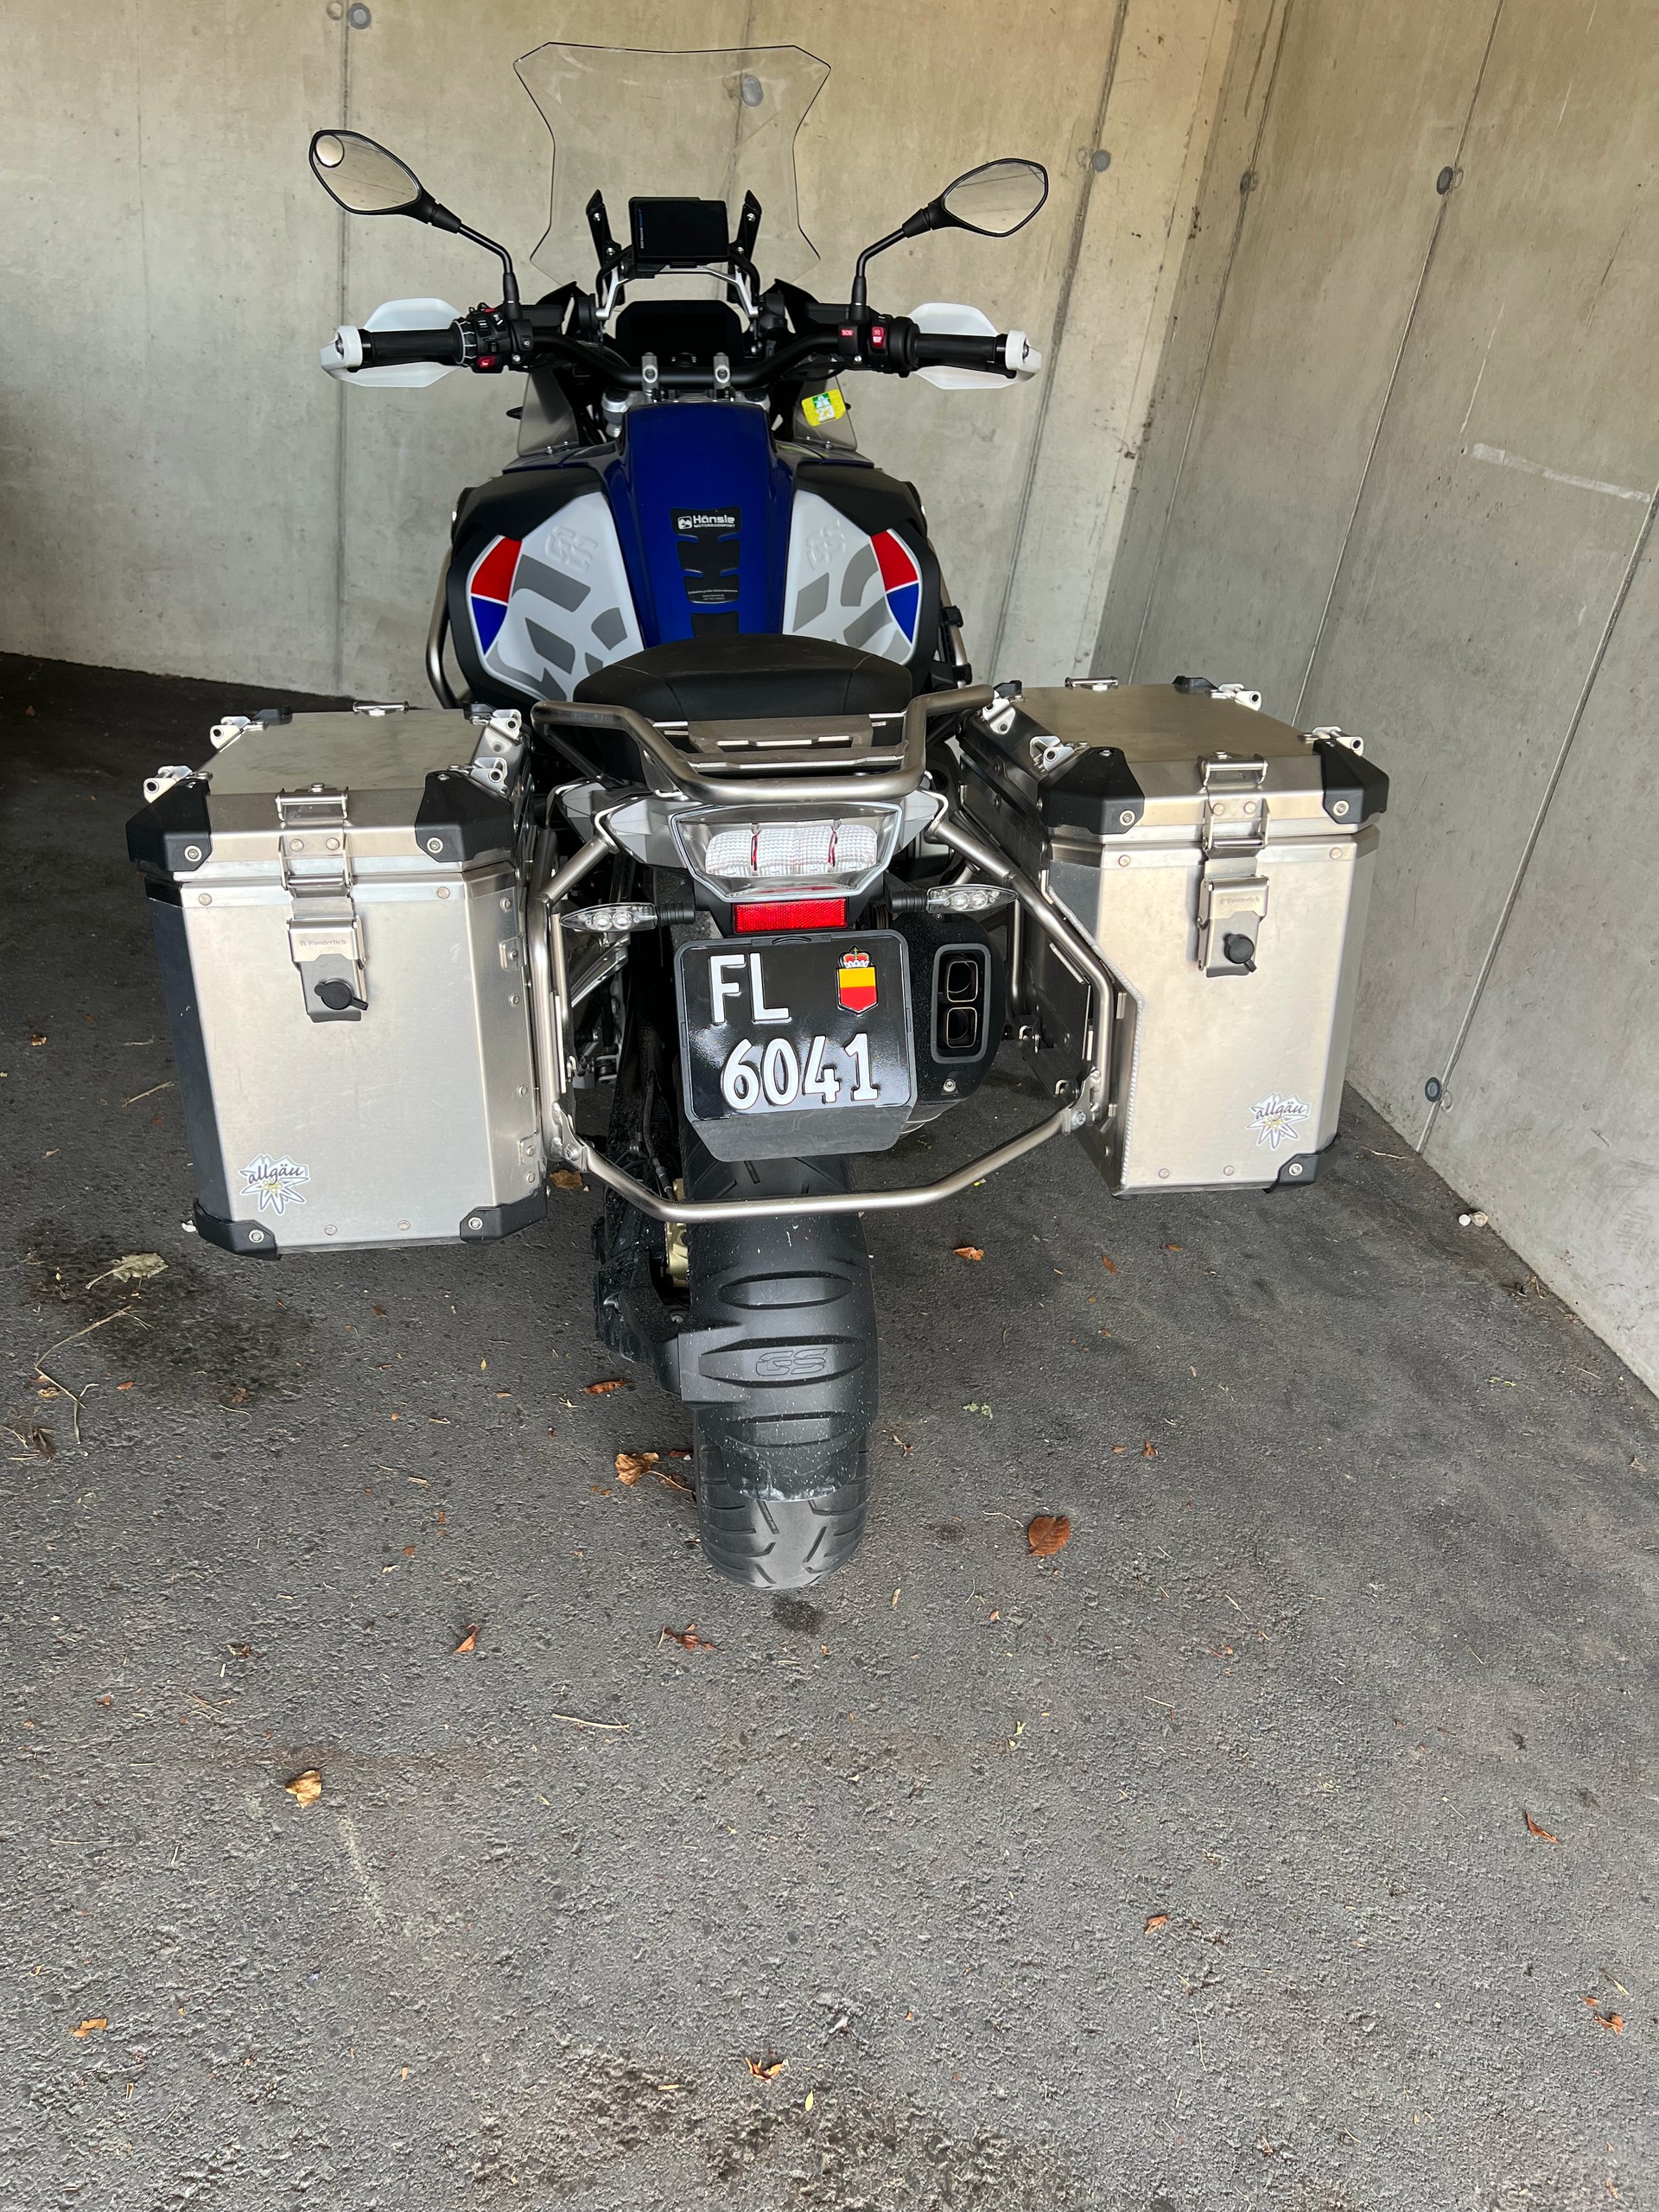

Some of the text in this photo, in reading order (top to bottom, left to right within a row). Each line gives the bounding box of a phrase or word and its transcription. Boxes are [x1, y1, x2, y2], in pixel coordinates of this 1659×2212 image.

[692, 514, 735, 524] Hänsle
[709, 952, 791, 1024] FL
[721, 1033, 880, 1110] 6041
[1255, 1101, 1306, 1122] allgäu
[249, 1164, 303, 1185] allgäu
[755, 1348, 828, 1376] GS
